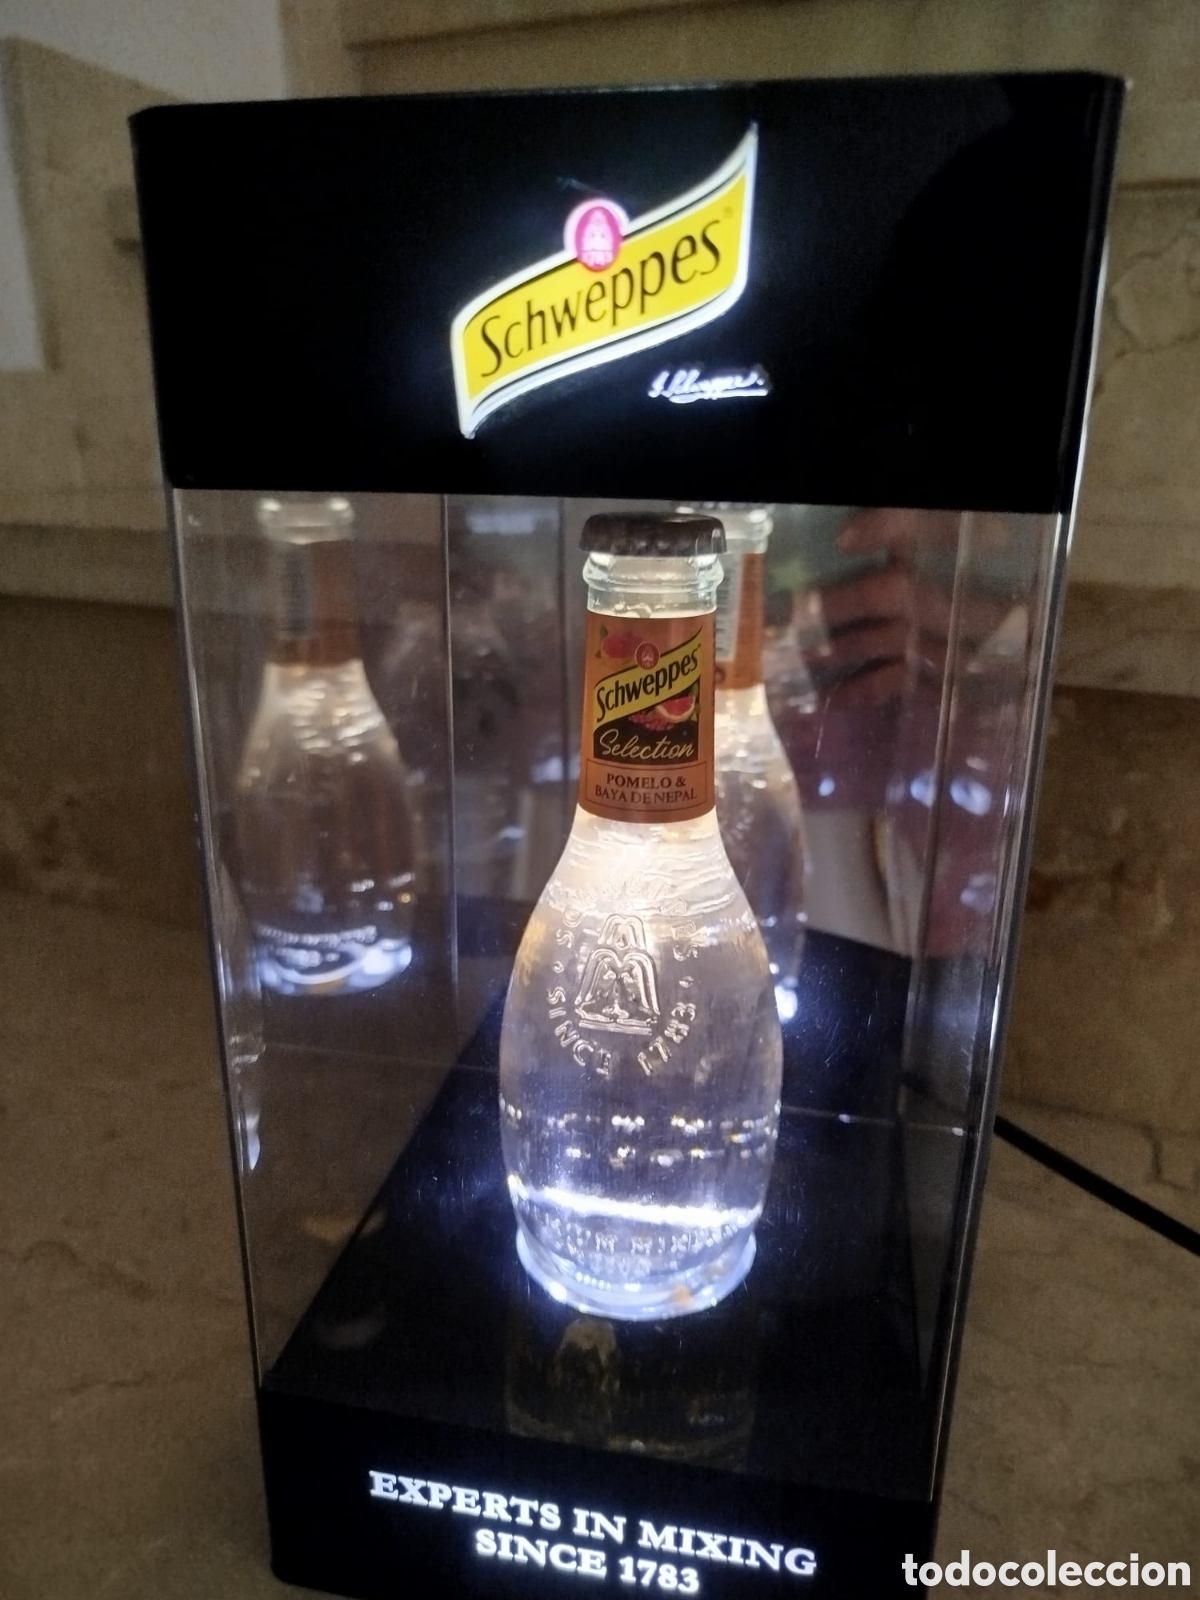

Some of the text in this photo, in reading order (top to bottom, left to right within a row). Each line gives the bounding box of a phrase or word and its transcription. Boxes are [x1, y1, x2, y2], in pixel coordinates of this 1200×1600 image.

[481, 219, 721, 378] Schweppes
[596, 649, 699, 723] Schweppes
[599, 728, 695, 761] Selection
[595, 784, 698, 804] BAYA DE NEPAL
[606, 772, 687, 790] POMELO &
[369, 1470, 817, 1577] EXPERTS IN MIXING
[475, 1529, 700, 1593] SINCE 1783
